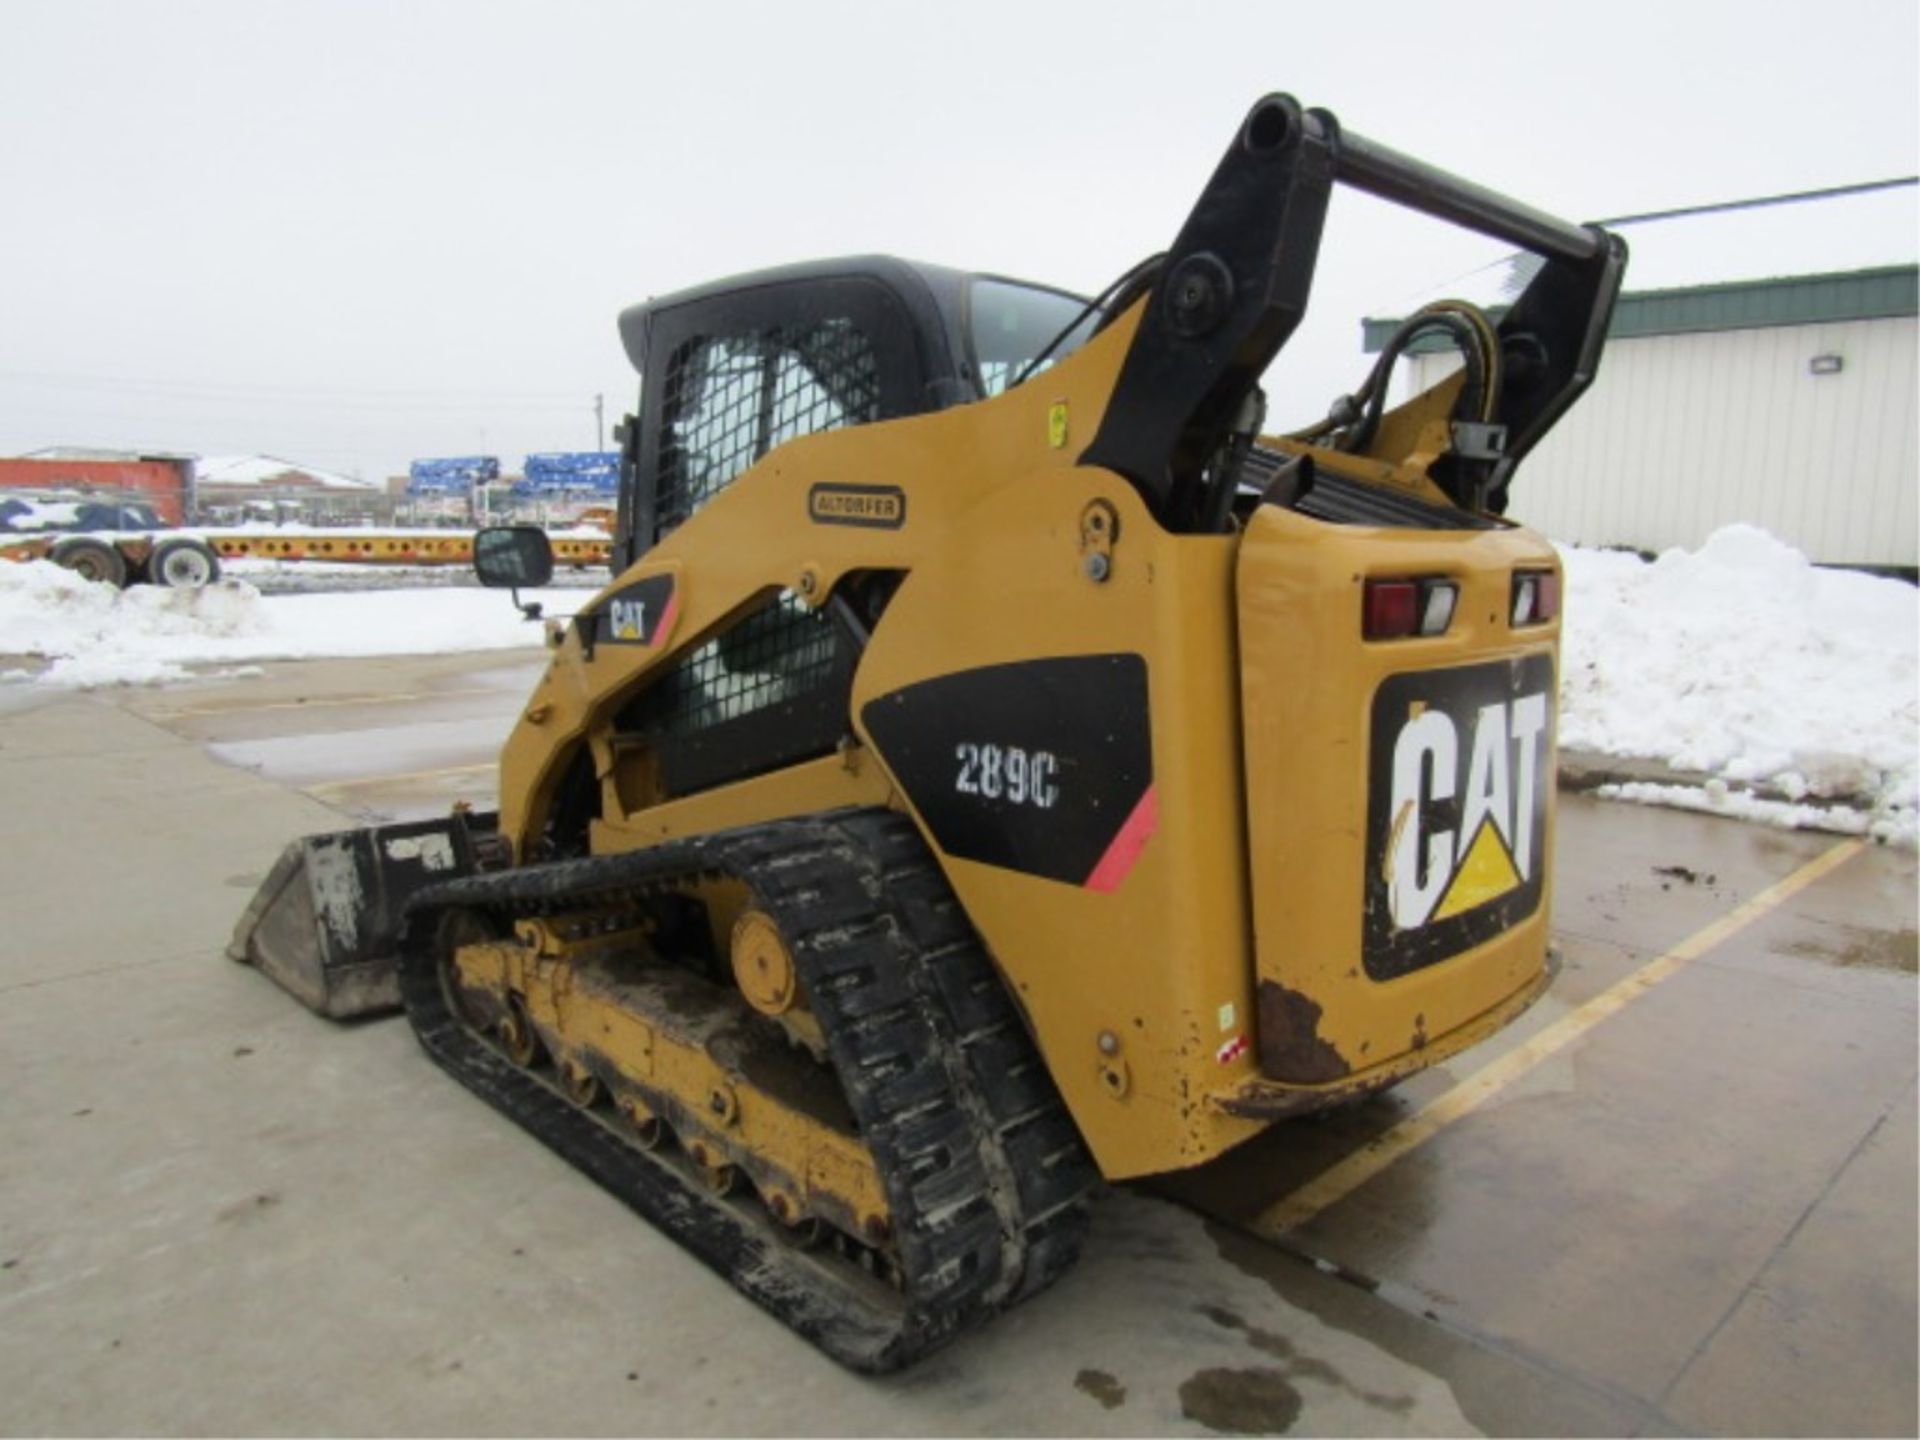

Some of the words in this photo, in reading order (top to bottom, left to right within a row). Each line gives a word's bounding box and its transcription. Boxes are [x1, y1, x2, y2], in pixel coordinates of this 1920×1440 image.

[817, 495, 895, 516] ALTORFER
[610, 599, 645, 639] CAT
[955, 742, 1059, 809] 289C
[1387, 692, 1546, 930] CAT
